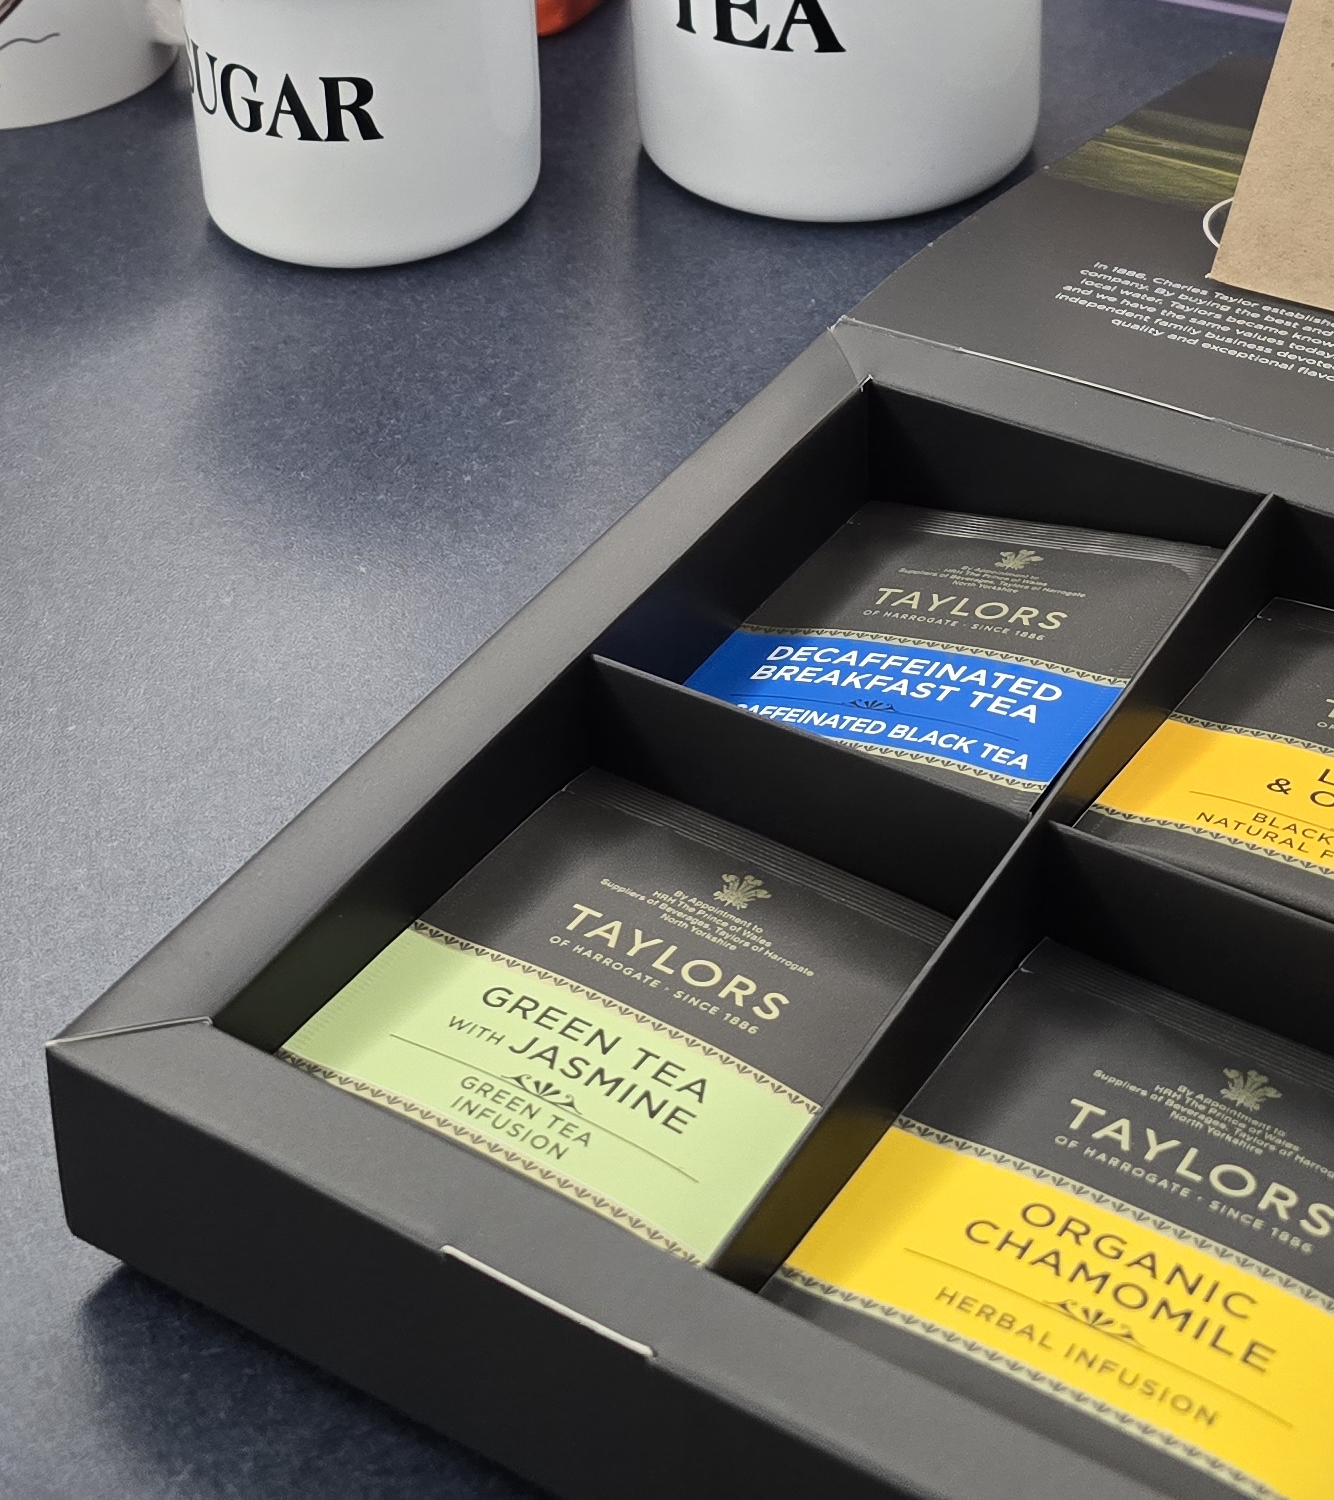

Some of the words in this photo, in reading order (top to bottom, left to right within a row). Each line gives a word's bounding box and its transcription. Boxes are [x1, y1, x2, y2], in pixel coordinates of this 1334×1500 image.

[1092, 261, 1109, 271] In
[1111, 265, 1148, 282] 1886,
[1152, 276, 1209, 297] Charles
[1214, 290, 1260, 309] Taylor
[873, 587, 1069, 631] TAYLORS
[750, 664, 962, 704] BREAKFAST
[970, 690, 1039, 724] TEA
[767, 645, 1064, 702] DECAFFEINATED
[887, 722, 971, 755] BLACK
[980, 741, 1030, 771] TEA
[1266, 776, 1293, 795] &
[1195, 810, 1311, 858] NATURAL
[1252, 811, 1334, 848] BLACK
[547, 934, 568, 949] OF
[571, 943, 662, 990] HARROGATE
[673, 987, 721, 1019] SINCE
[721, 1012, 760, 1036] 1886
[562, 902, 792, 1024] TAYLORS
[446, 1014, 506, 1048] WITH
[506, 1035, 700, 1137] JASMINE
[480, 985, 624, 1056] GREEN
[633, 1045, 710, 1105] TEA
[449, 1094, 571, 1163] INFUSION
[459, 1074, 543, 1121] GREEN
[544, 1113, 594, 1149] TEA
[1019, 1200, 1261, 1324] ORGANIC
[963, 1219, 1281, 1375] CHAMOMILE
[935, 1285, 1056, 1354] HERBAL
[1062, 1342, 1219, 1430] INFUSION
